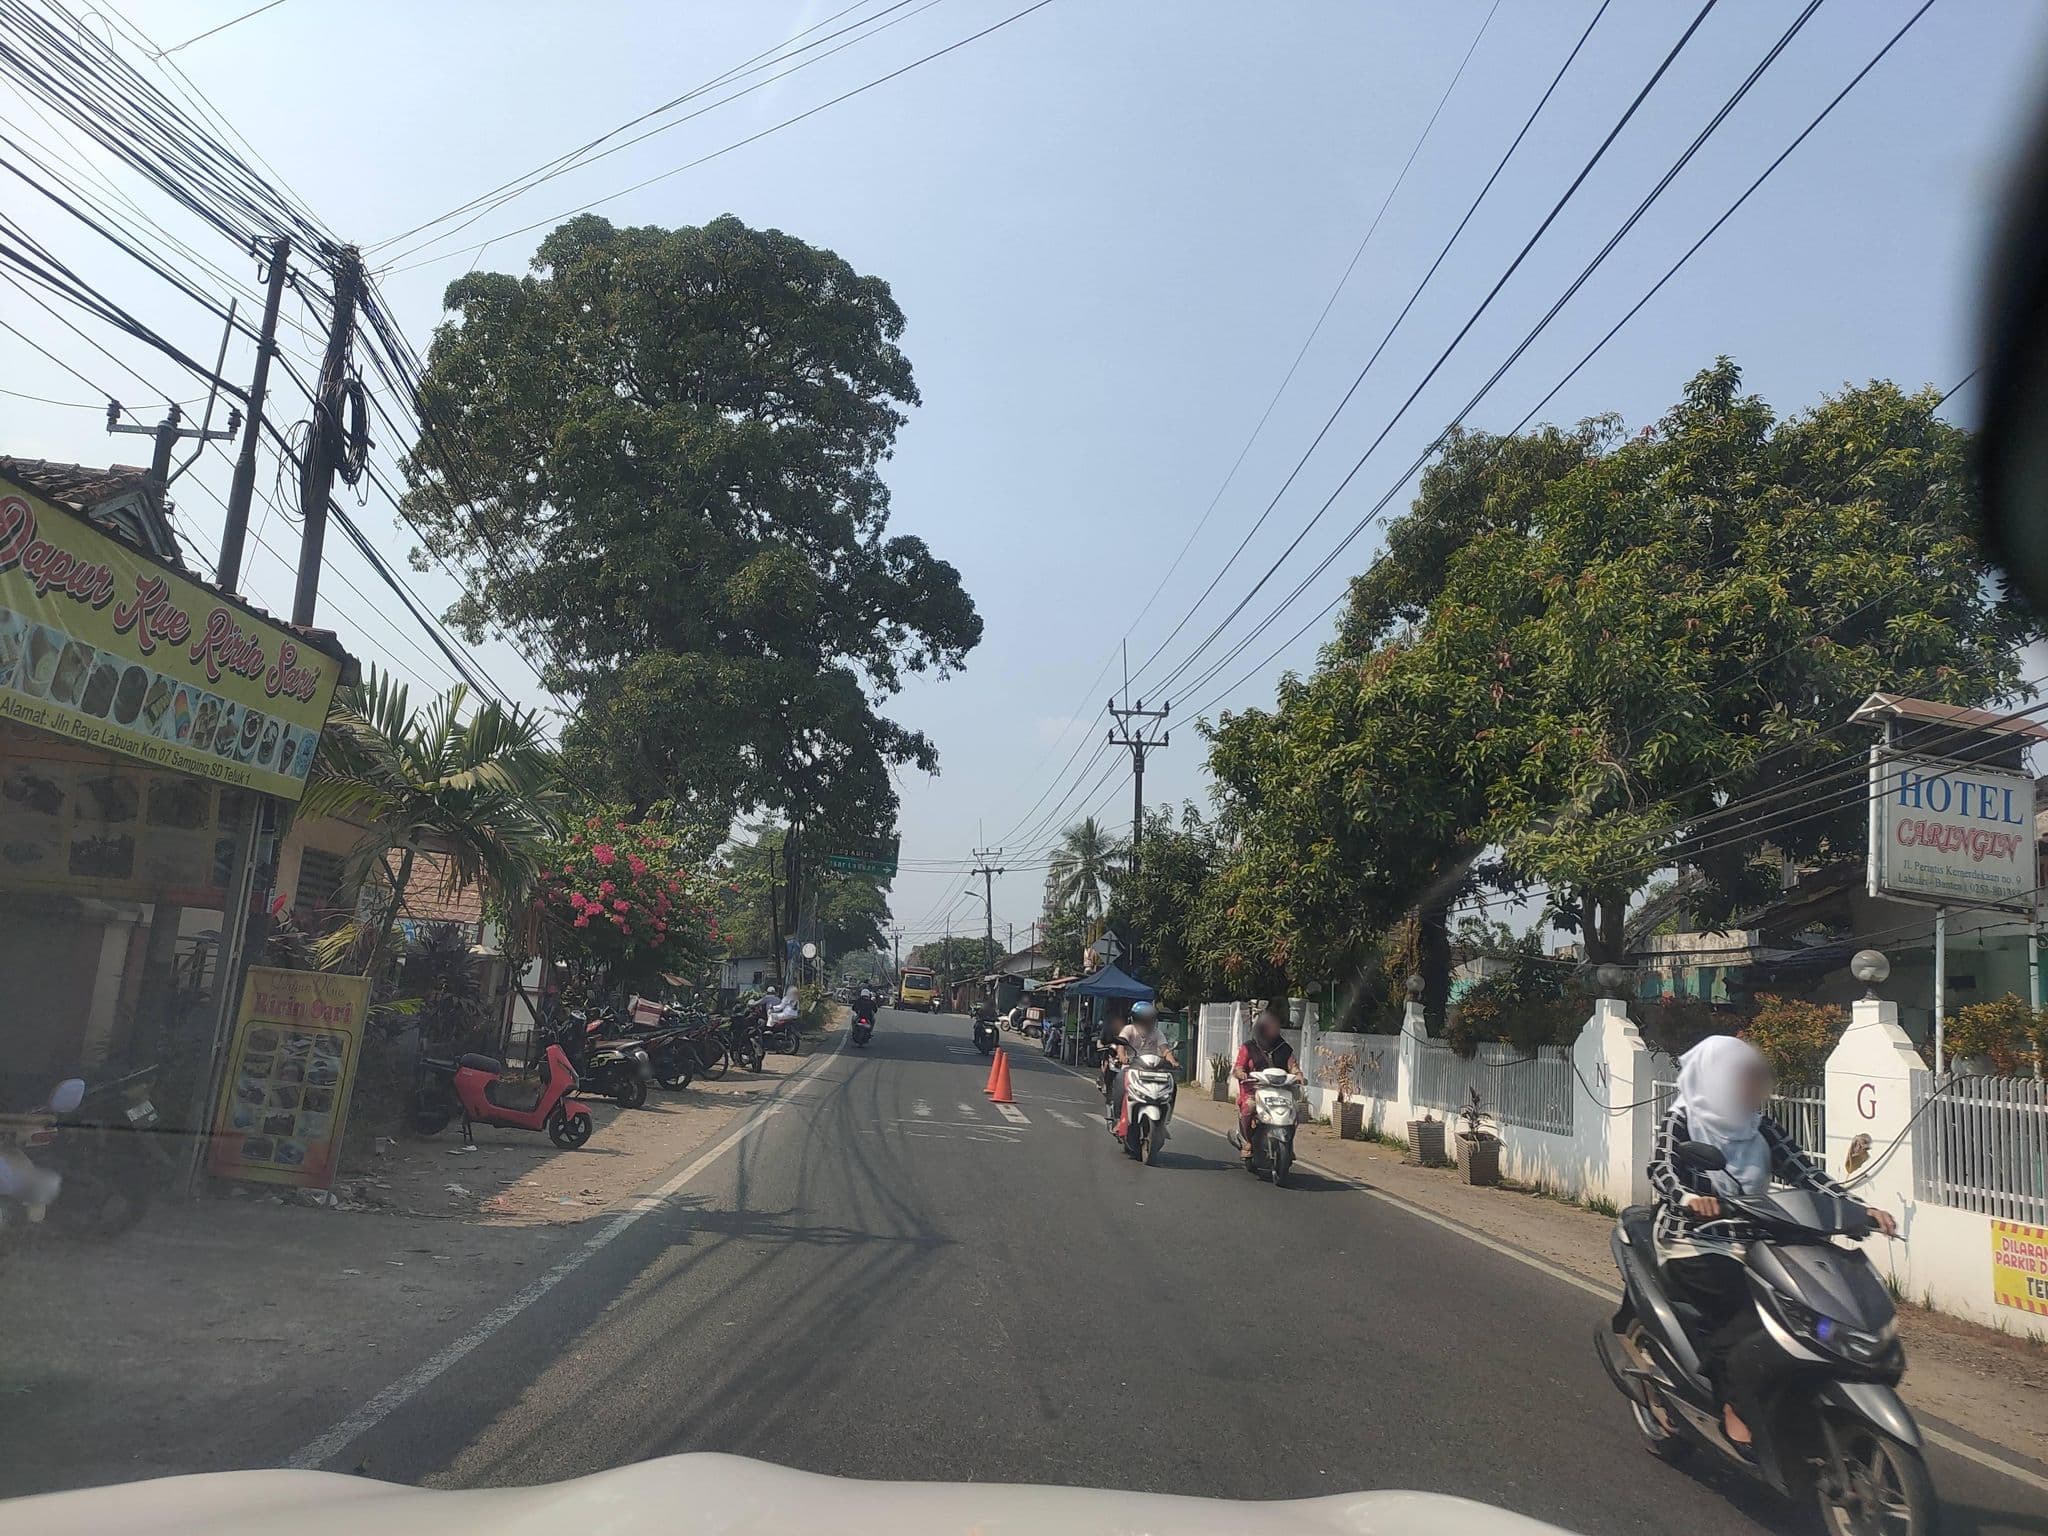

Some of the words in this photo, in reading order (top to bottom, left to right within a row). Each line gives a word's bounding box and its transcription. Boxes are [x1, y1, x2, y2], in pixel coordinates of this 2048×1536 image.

[113, 573, 191, 652] Kue
[191, 608, 265, 680] Ririn
[265, 640, 321, 700] Sari
[0, 697, 49, 725] Alamat:
[51, 713, 69, 732] Jln
[72, 719, 100, 741] Raya
[101, 729, 139, 753] Labuan
[141, 742, 157, 758] Km
[159, 748, 171, 762] 07
[171, 751, 209, 774] Samping
[210, 763, 222, 777] SD
[224, 767, 245, 784] Teluk
[1898, 770, 2023, 825] HOTEL
[1896, 818, 2023, 864] CARINGIN
[1596, 1062, 1608, 1088] N
[1857, 1083, 1877, 1120] G
[1995, 1251, 2036, 1272] PARKIR
